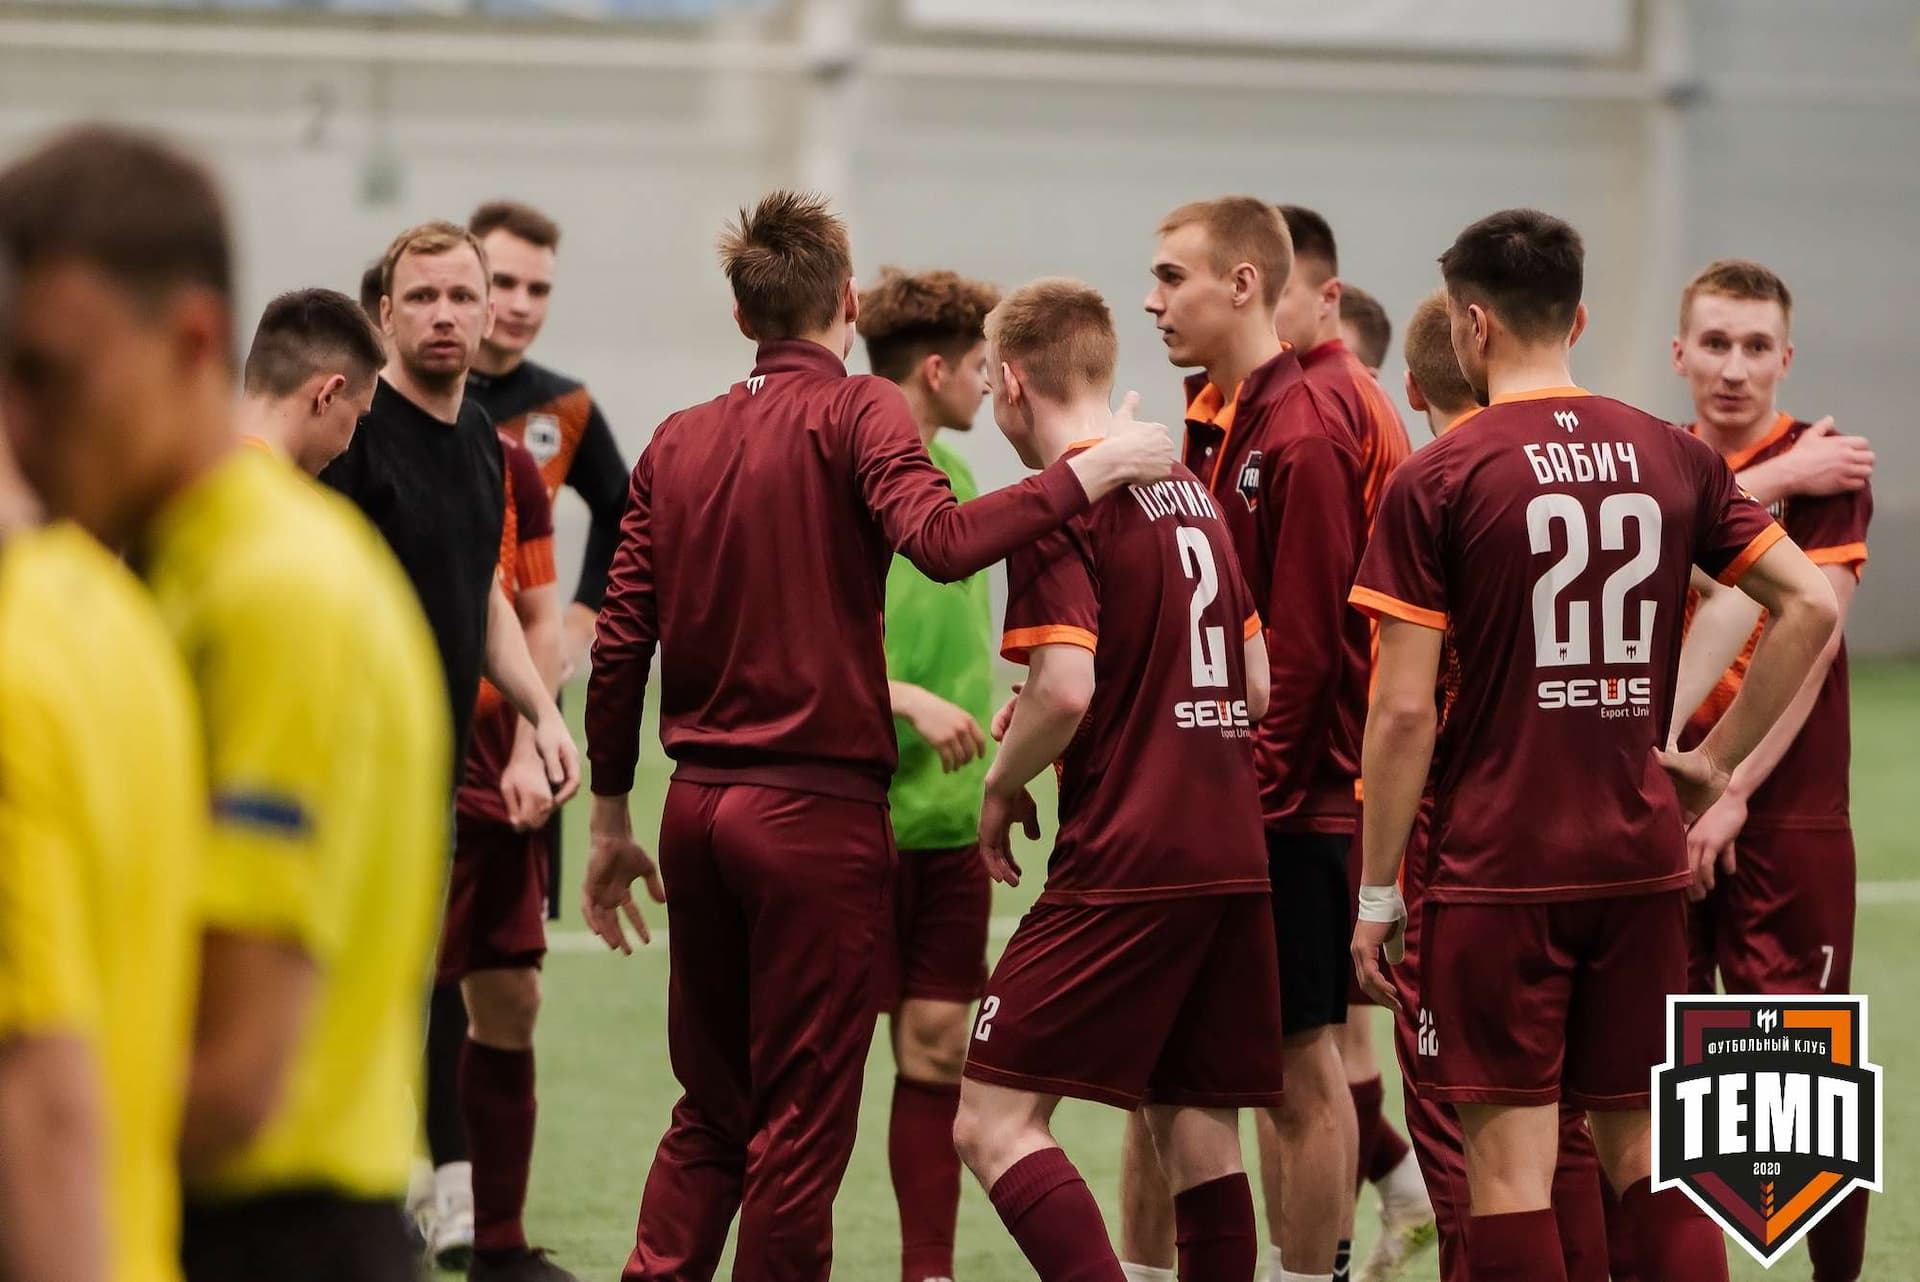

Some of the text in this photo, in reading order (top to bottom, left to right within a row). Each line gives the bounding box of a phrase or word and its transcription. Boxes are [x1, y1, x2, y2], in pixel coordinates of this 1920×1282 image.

[1523, 441, 1640, 485] БАБИЧ
[1526, 493, 1661, 667] 22
[1175, 525, 1228, 688] 2
[1174, 699, 1250, 729] SEUS
[1538, 677, 1651, 709] SEUS
[1600, 706, 1630, 720] Export
[1819, 944, 1834, 990] 7
[974, 994, 1001, 1042] 2
[1418, 1008, 1439, 1056] 22
